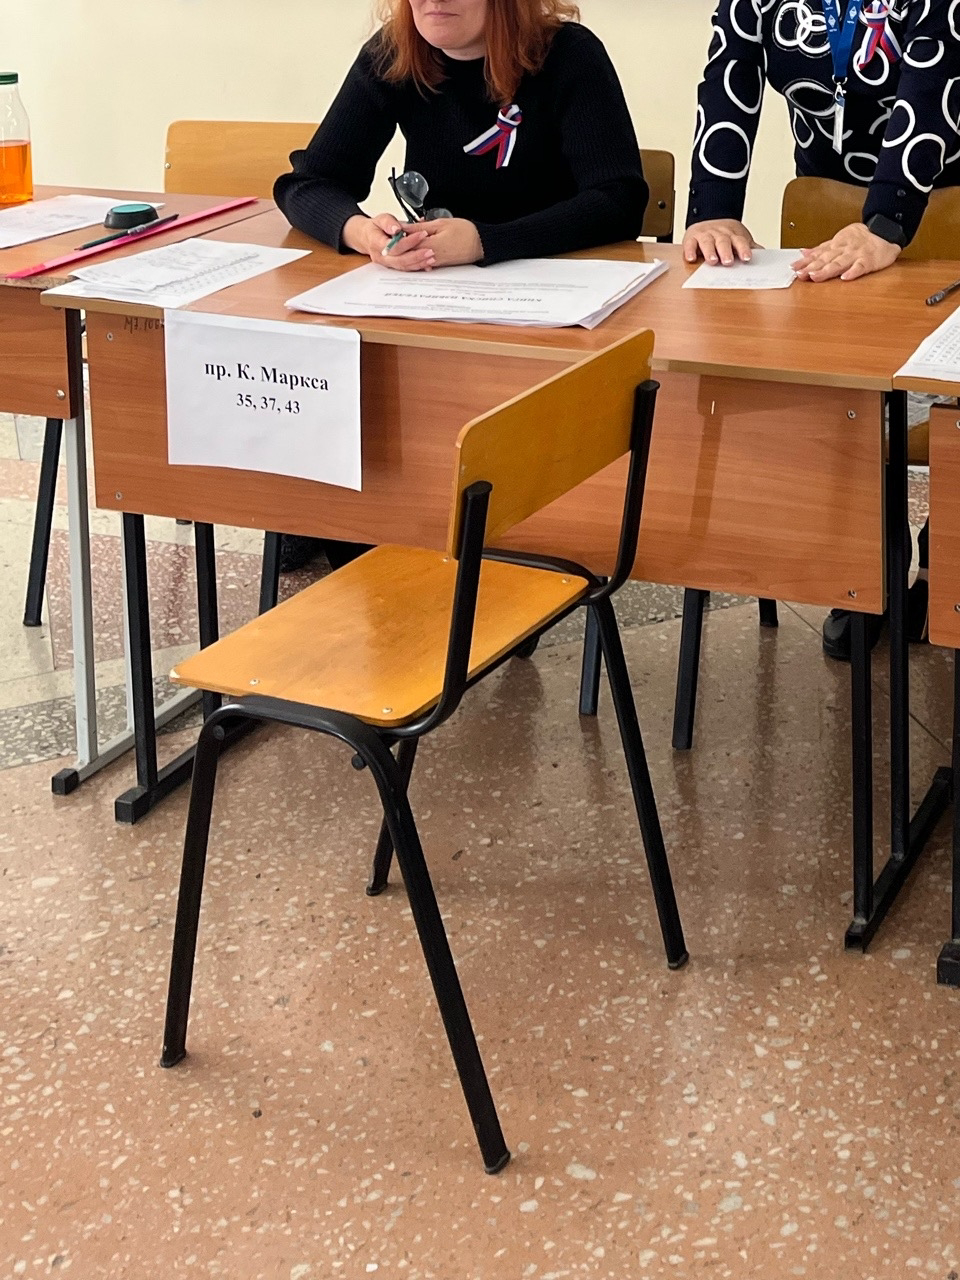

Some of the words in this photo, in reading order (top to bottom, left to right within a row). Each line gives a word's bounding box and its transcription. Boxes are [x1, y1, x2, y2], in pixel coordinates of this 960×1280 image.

[204, 363, 231, 381] пр.
[236, 362, 255, 380] К.
[260, 366, 329, 391] Маркса
[236, 393, 256, 410] 35,
[260, 396, 281, 414] 37,
[284, 400, 300, 415] 43
